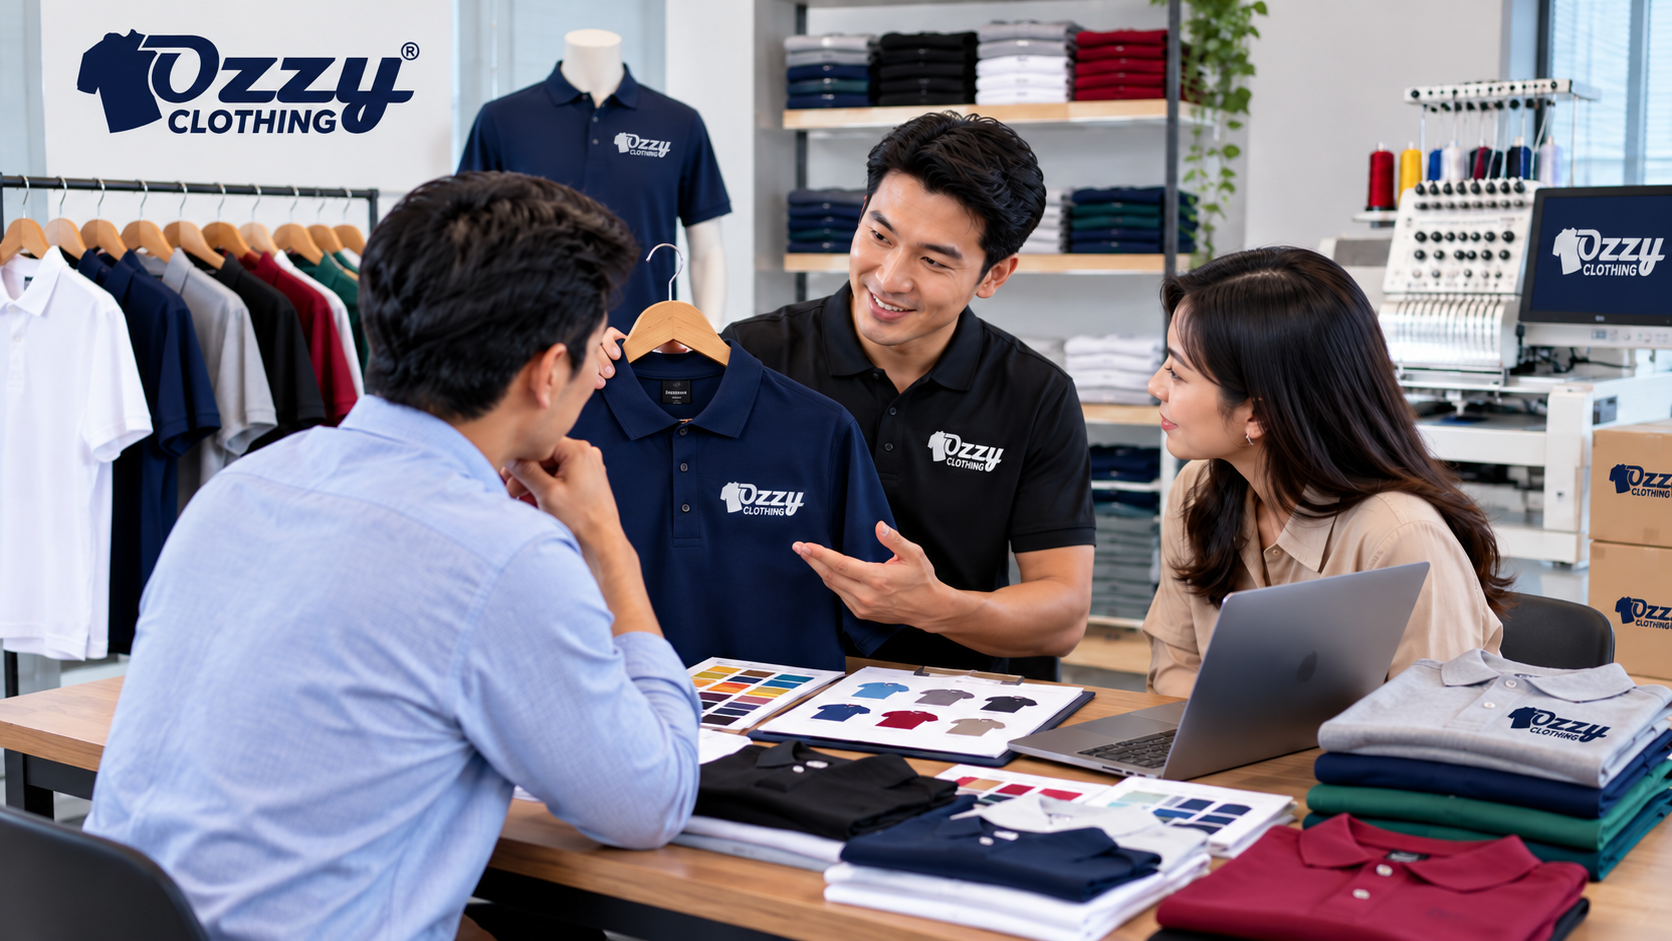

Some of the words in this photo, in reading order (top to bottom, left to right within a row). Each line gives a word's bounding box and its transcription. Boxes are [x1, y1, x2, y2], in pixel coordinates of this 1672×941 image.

[168, 109, 337, 134] CLOTHING
[626, 133, 671, 158] Ozzy
[1577, 229, 1666, 277] Ozzy
[1583, 264, 1638, 277] CLOTHING
[945, 433, 1005, 472] Ozzy
[946, 457, 985, 472] CLOTHING
[1627, 465, 1672, 490] Ozz
[739, 483, 805, 516] Ozzy
[1631, 487, 1671, 499] CLOTHING
[743, 506, 785, 516] CLOTHING
[1632, 598, 1672, 622] Ozz
[1635, 619, 1670, 630] CLOTHING
[1529, 727, 1580, 741] CLOTHING
[1532, 709, 1612, 743] Ozzy
